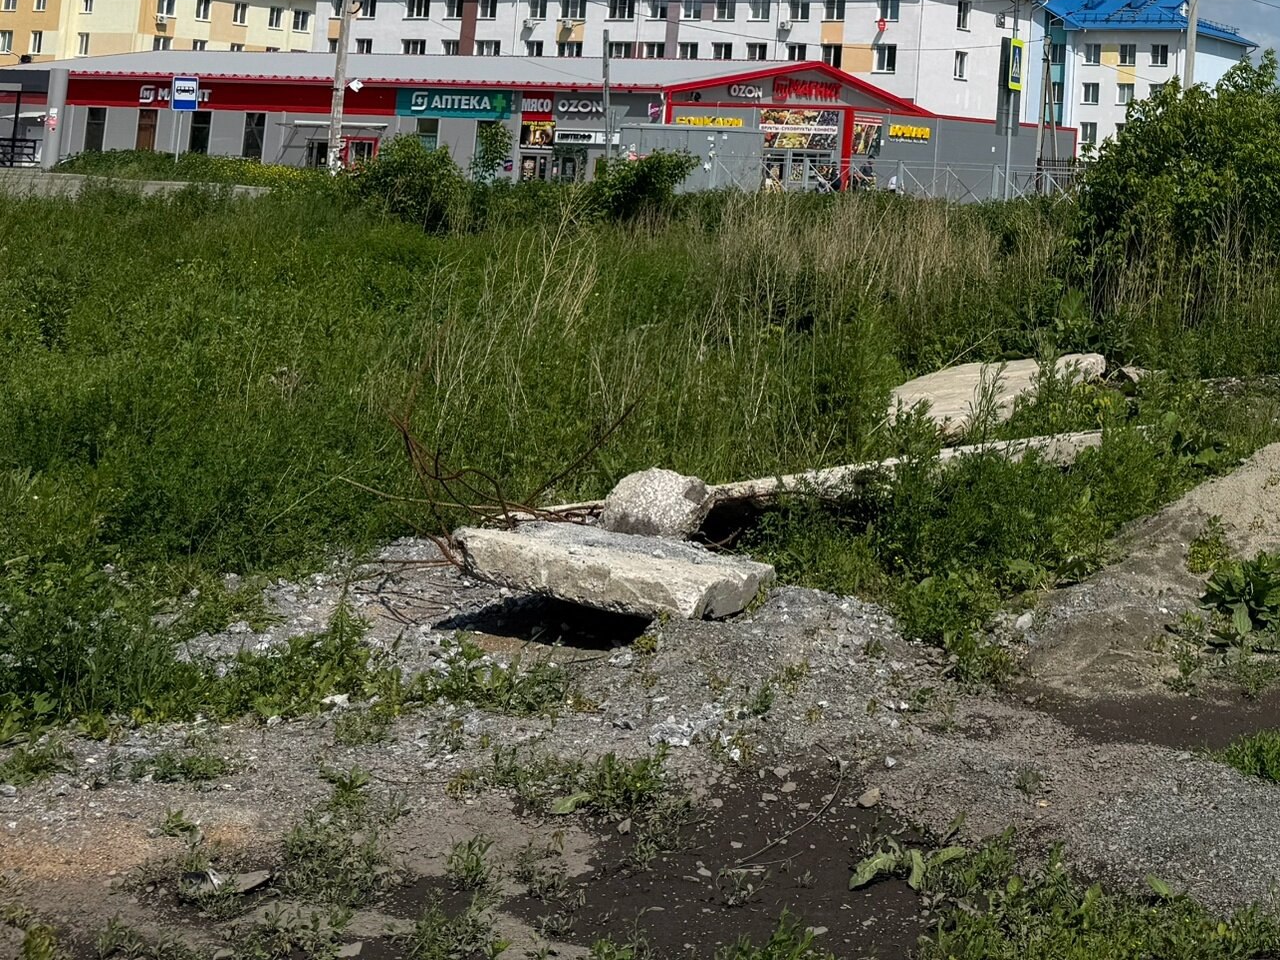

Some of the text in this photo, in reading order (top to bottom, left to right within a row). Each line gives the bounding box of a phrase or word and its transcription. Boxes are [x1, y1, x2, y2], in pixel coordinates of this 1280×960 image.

[730, 84, 763, 98] OZON
[431, 95, 491, 109] АПТЕКА
[521, 98, 552, 113] МЯСО
[558, 100, 604, 113] OZON
